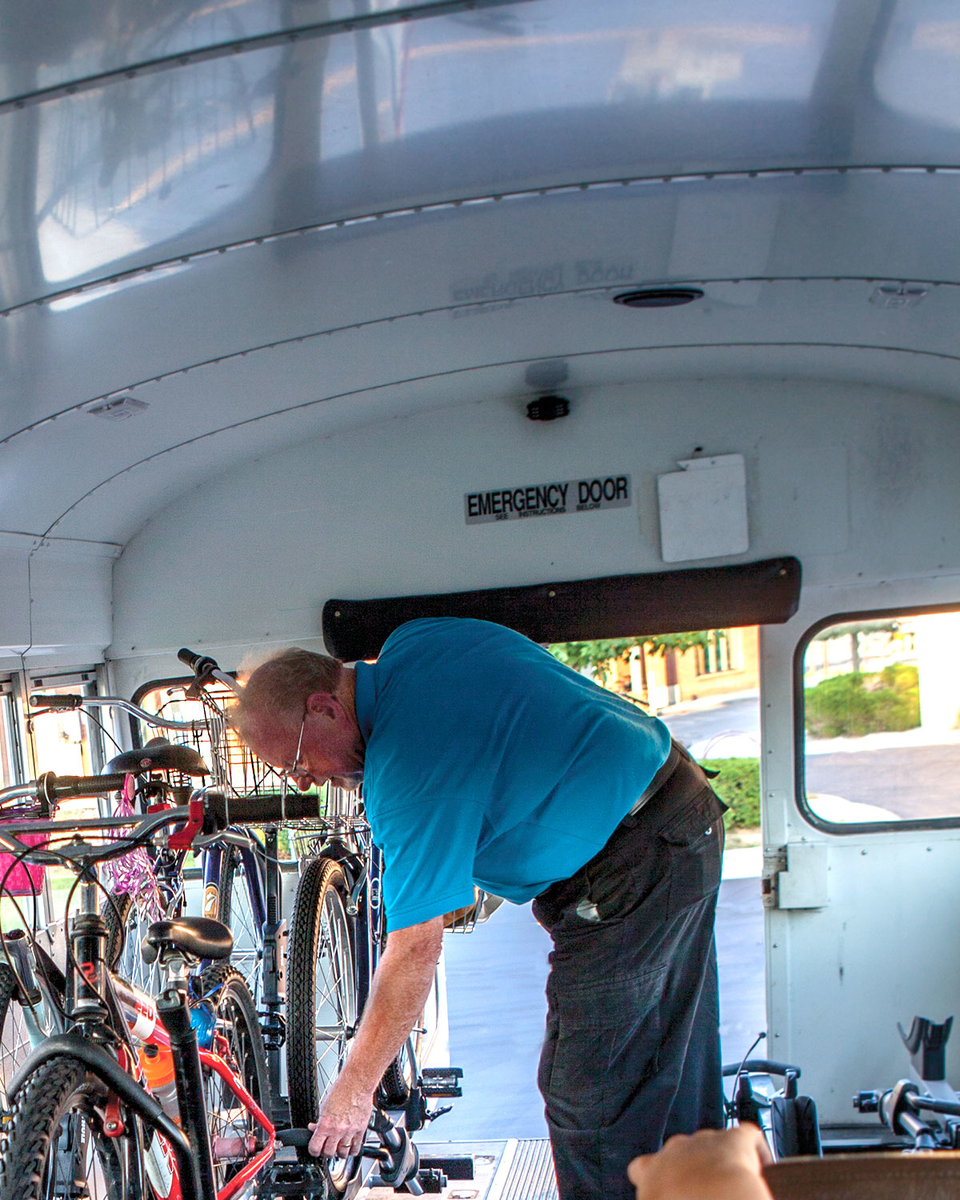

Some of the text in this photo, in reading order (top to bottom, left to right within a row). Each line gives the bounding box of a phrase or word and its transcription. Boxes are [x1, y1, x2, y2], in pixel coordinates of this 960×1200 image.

[468, 476, 628, 517] EMERGENCY DOOR
[519, 506, 567, 518] INSTRUCTIONS
[576, 502, 601, 511] BELOW
